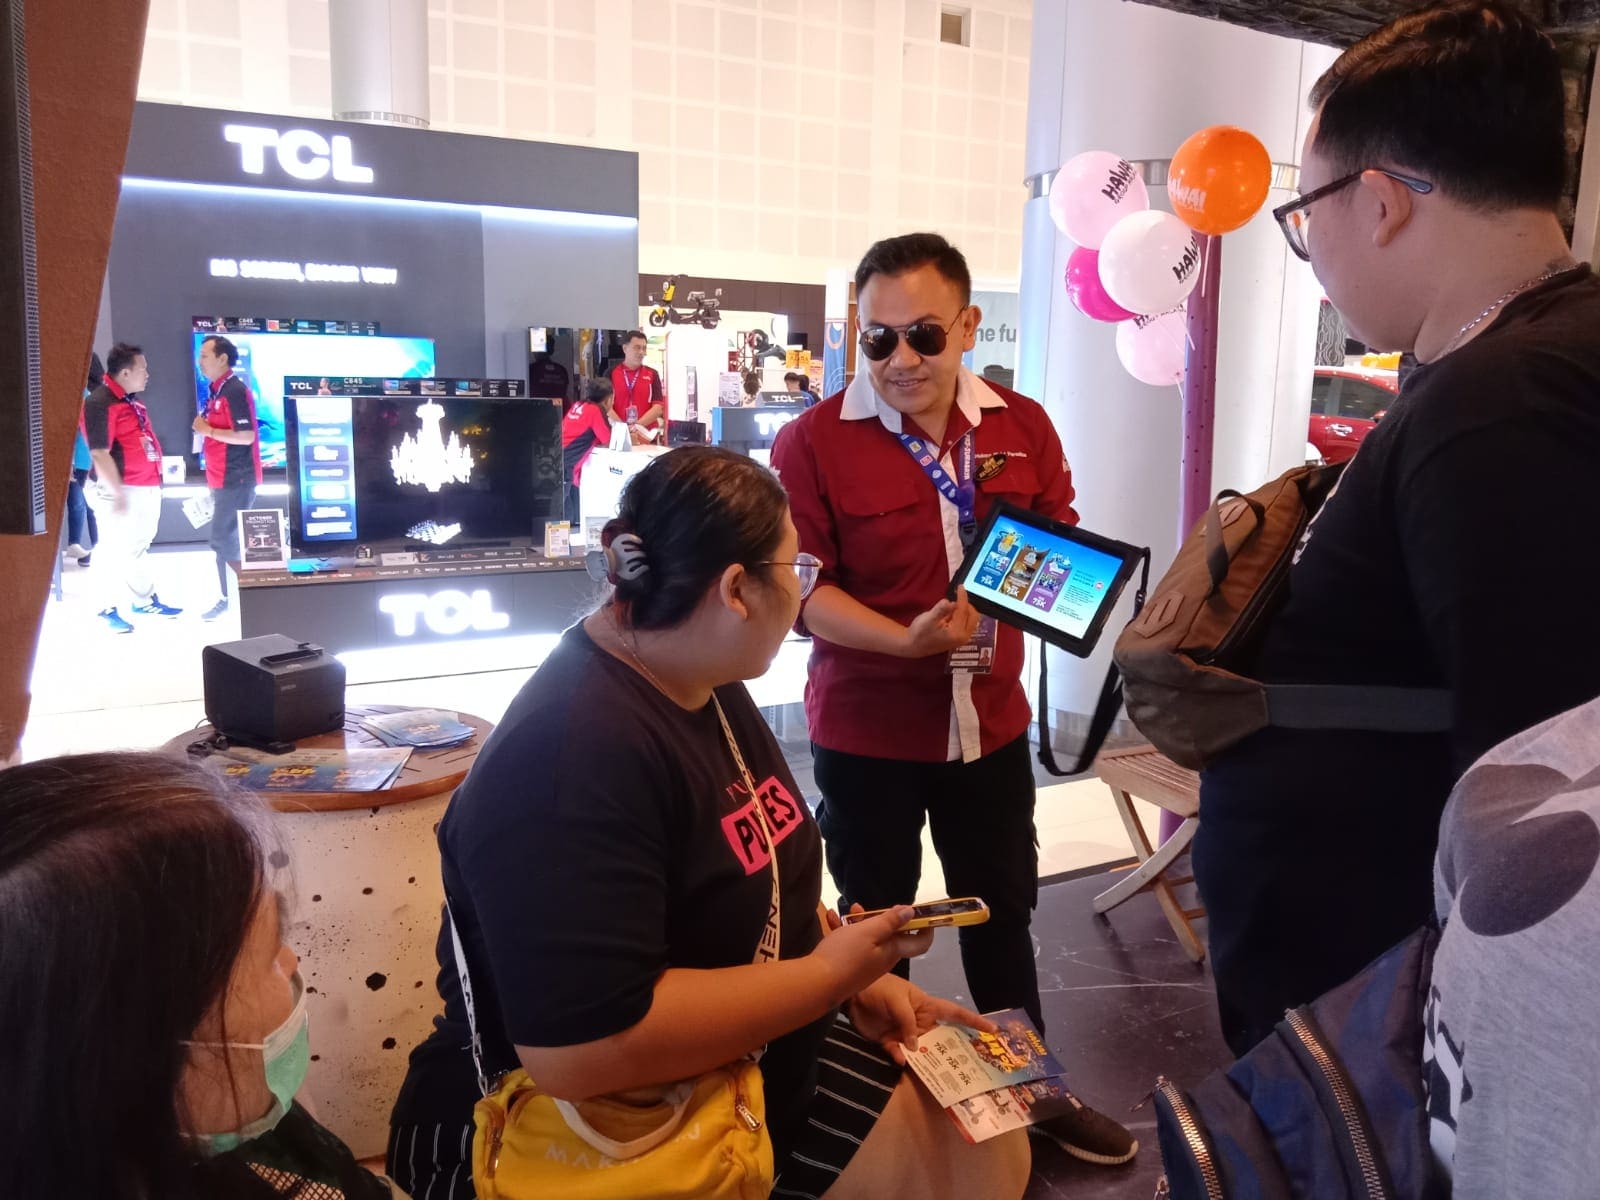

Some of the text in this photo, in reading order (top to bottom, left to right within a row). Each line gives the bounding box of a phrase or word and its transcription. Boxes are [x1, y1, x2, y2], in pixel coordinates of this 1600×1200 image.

[224, 124, 374, 183] TCL
[1168, 177, 1207, 210] AWAI
[1172, 236, 1199, 280] HAW
[290, 382, 312, 390] TCL
[771, 395, 796, 403] TCL
[754, 412, 800, 435] TC
[379, 589, 510, 636] TCL
[1032, 597, 1046, 608] 75K
[934, 1042, 948, 1057] 75K
[958, 1071, 971, 1086] 75K
